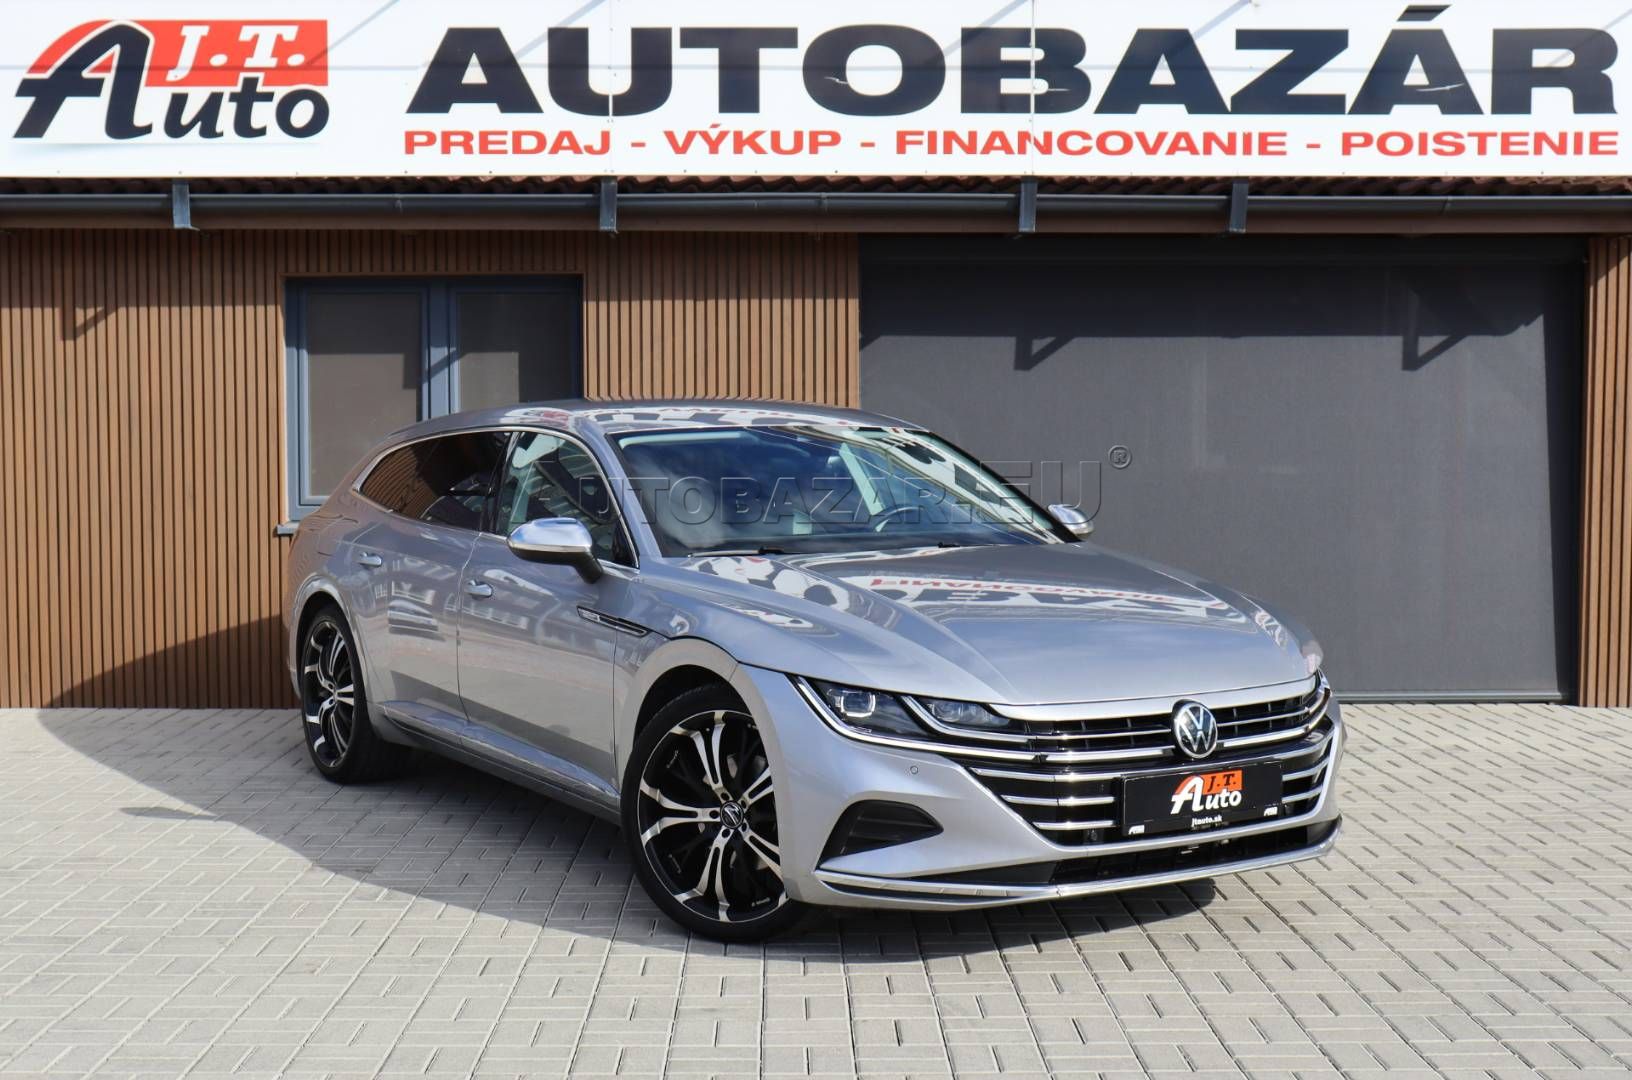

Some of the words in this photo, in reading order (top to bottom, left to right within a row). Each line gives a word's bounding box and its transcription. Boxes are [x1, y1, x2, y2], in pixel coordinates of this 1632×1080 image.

[13, 24, 330, 140] Auto
[165, 24, 305, 82] J.T.
[406, 5, 1618, 117] AUTOBAZÁR
[404, 130, 611, 156] PREDAJ
[665, 124, 842, 155] VÝKUP
[896, 130, 1286, 157] FINANCOVANIE
[1341, 131, 1617, 157] POISTENIE
[1170, 776, 1243, 815] Auto
